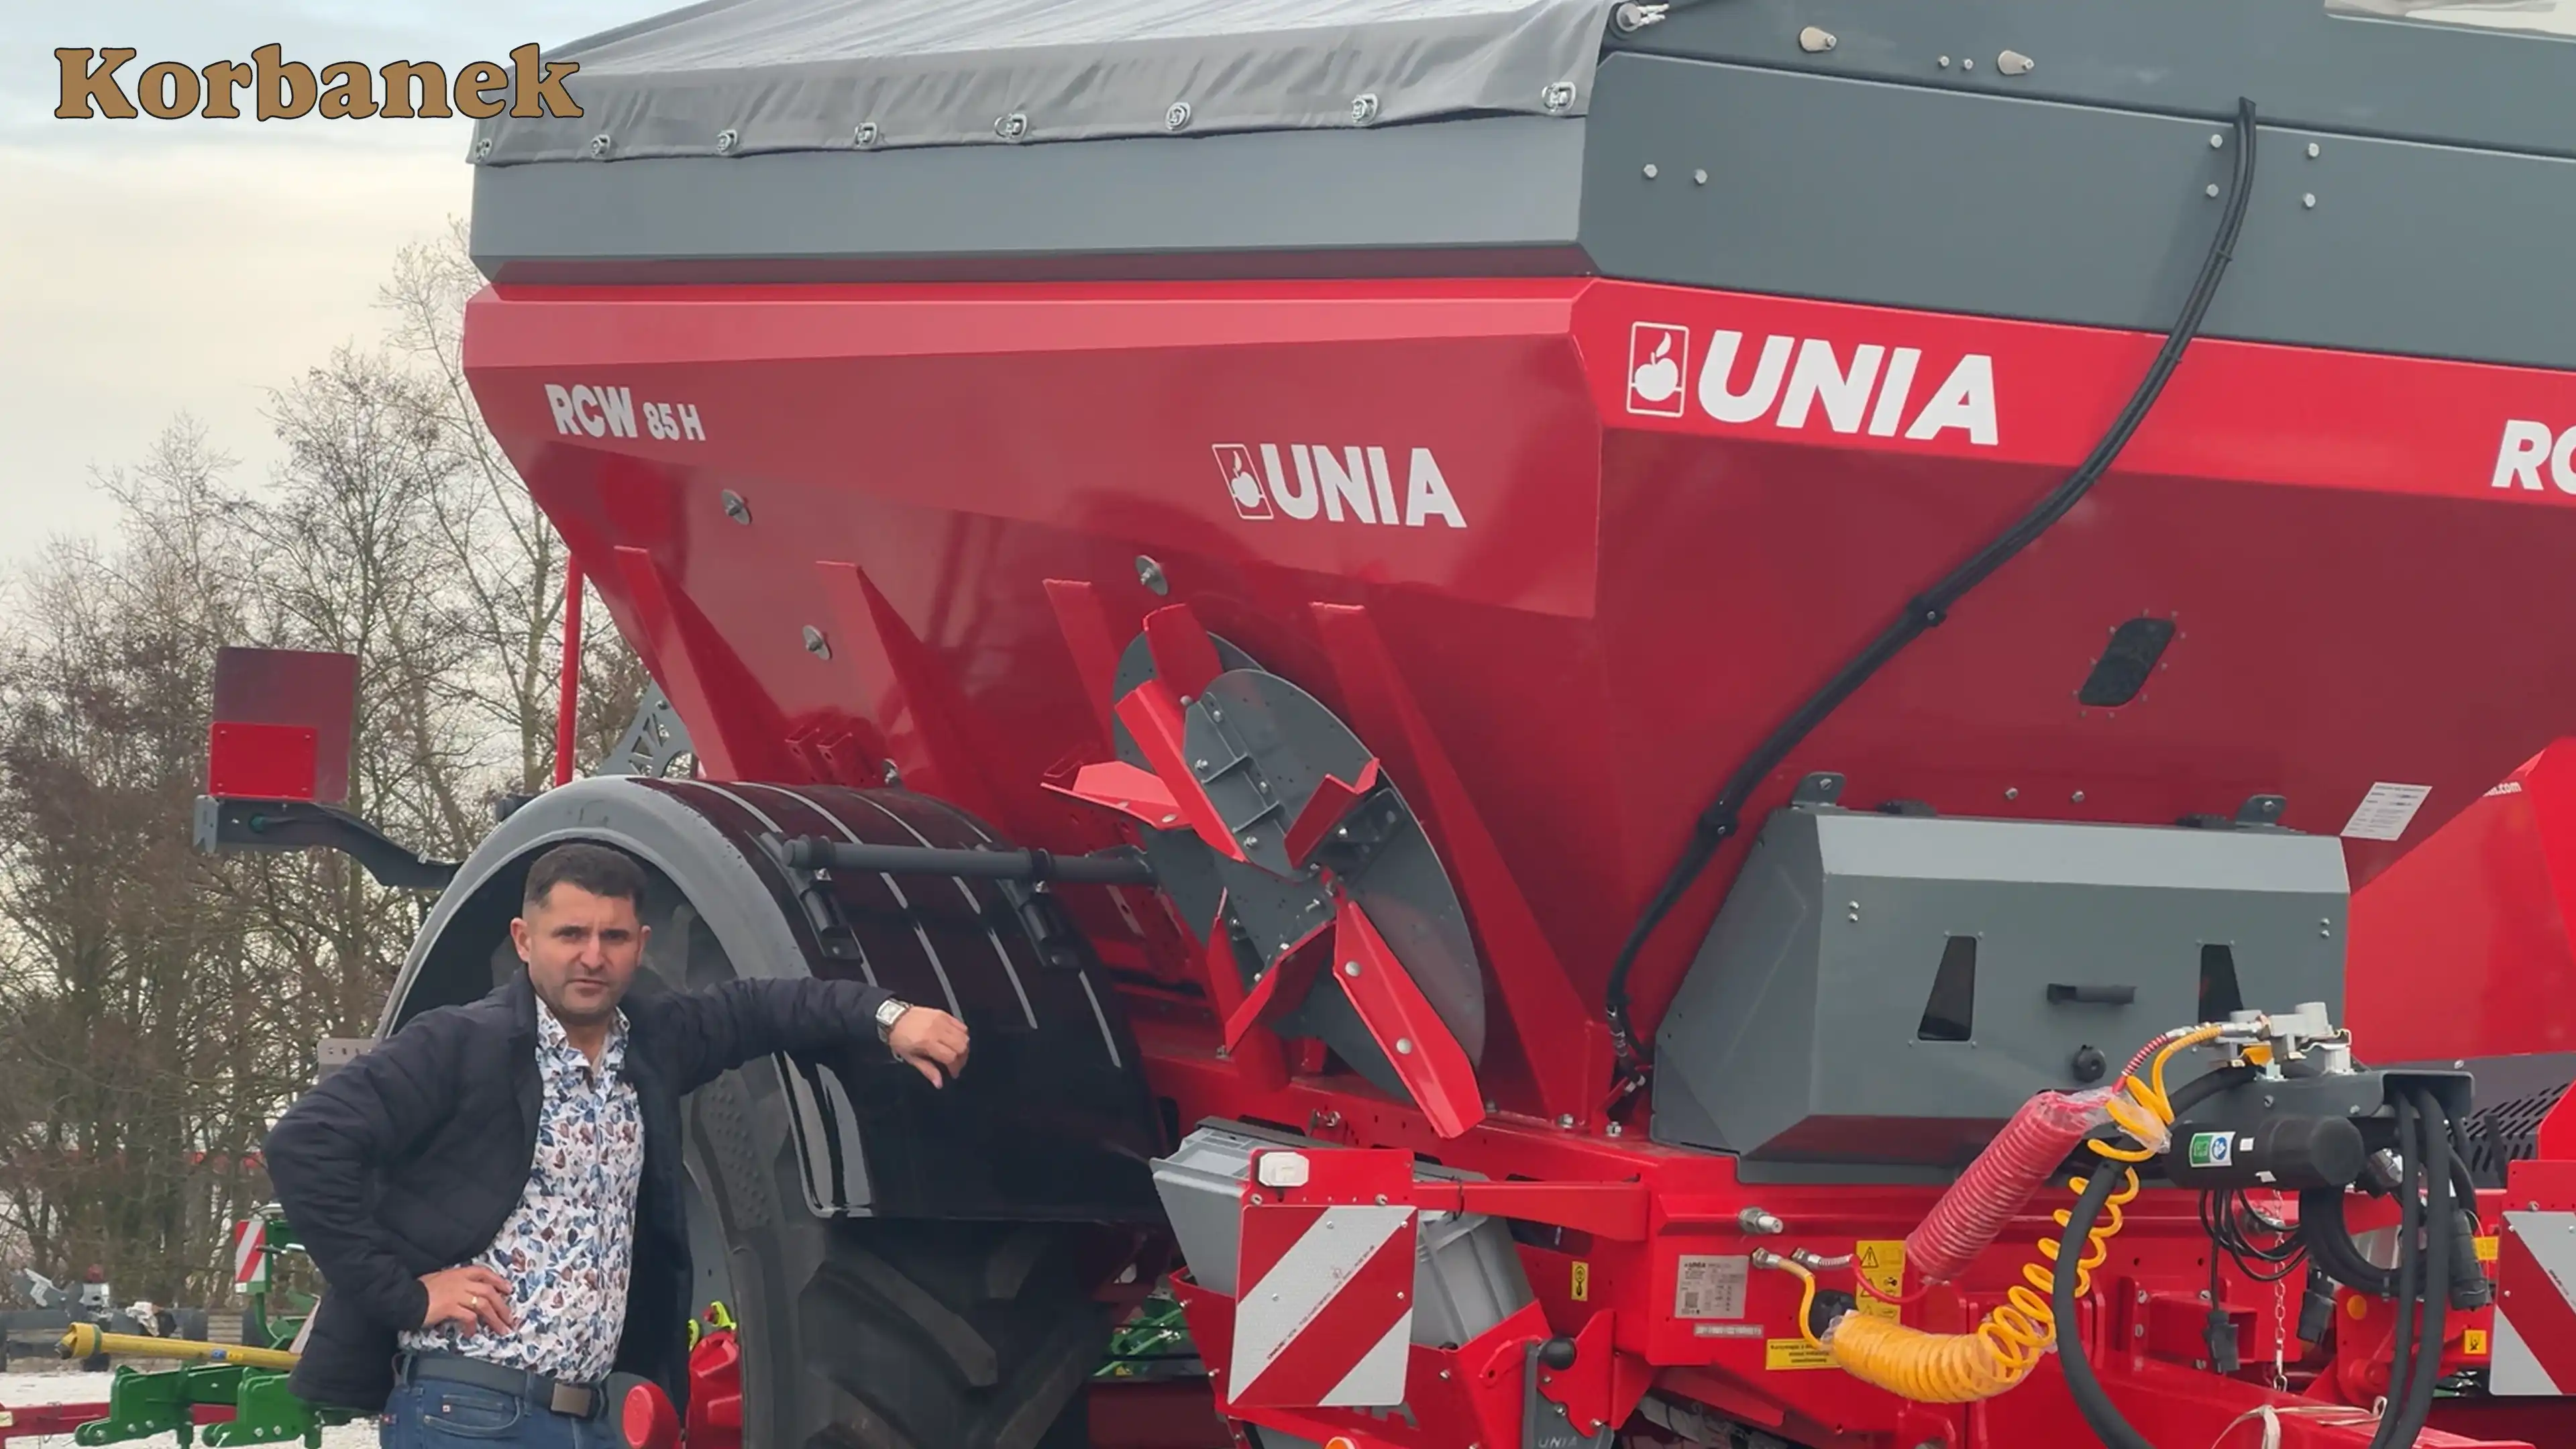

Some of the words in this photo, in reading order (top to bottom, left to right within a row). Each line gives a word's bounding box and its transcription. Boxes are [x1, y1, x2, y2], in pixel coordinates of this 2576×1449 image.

[544, 384, 638, 438] RCW
[643, 402, 680, 441] 85
[677, 404, 706, 441] H
[1698, 329, 1998, 445] UNIA
[1260, 443, 1467, 528] UNIA
[1538, 1436, 1577, 1448] UNIA
